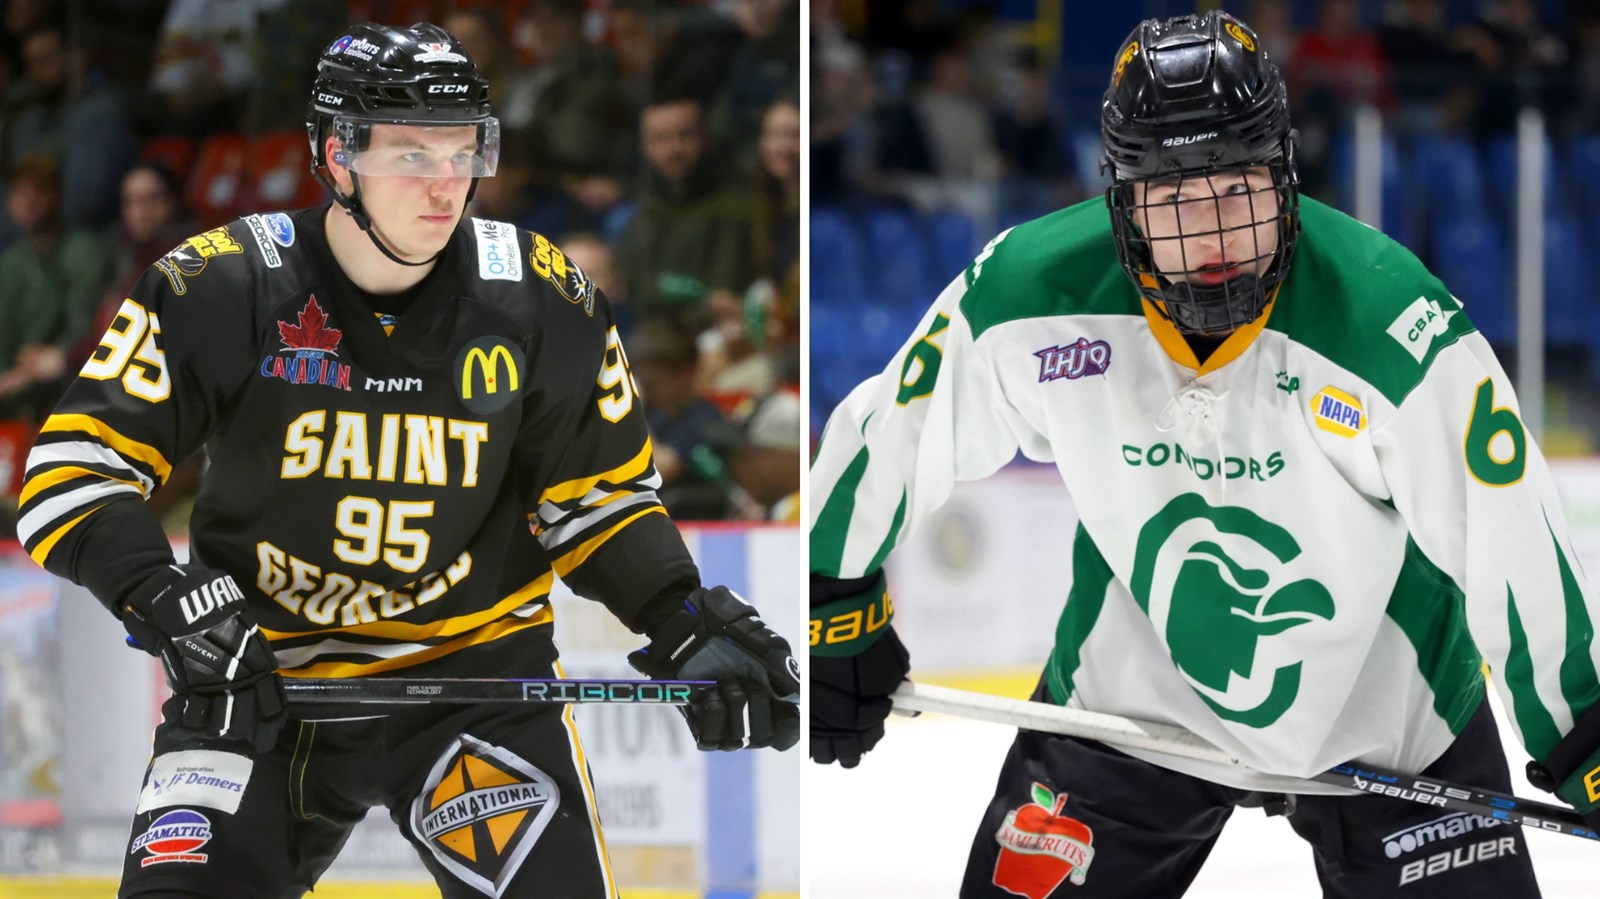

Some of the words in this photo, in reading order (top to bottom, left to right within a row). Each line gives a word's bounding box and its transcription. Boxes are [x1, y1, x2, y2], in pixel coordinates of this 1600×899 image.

[351, 38, 380, 55] SPORTS
[318, 92, 343, 106] CCM
[428, 84, 469, 94] CCM
[268, 214, 287, 236] Ford
[487, 243, 505, 276] OP+
[1408, 310, 1437, 343] CBA
[261, 355, 350, 391] CANADIAN
[596, 324, 640, 424] 9
[896, 310, 951, 407] 6
[364, 377, 423, 392] MNM
[1320, 395, 1360, 430] NAPA
[280, 409, 489, 487] SAINT
[1464, 375, 1527, 488] 6
[1122, 442, 1285, 482] CONDORS
[333, 495, 435, 573] 95
[185, 640, 218, 662] COVERT
[522, 682, 691, 703] RIBCOR
[167, 773, 186, 788] JF
[185, 772, 243, 792] Demers
[1369, 782, 1448, 807] BAUER
[425, 787, 541, 832] INTERNATIONAL
[132, 826, 208, 851] STEAMATIC
[1417, 811, 1512, 848] mana
[1031, 837, 1087, 867] FRUITS
[1399, 836, 1518, 887] BAUER
